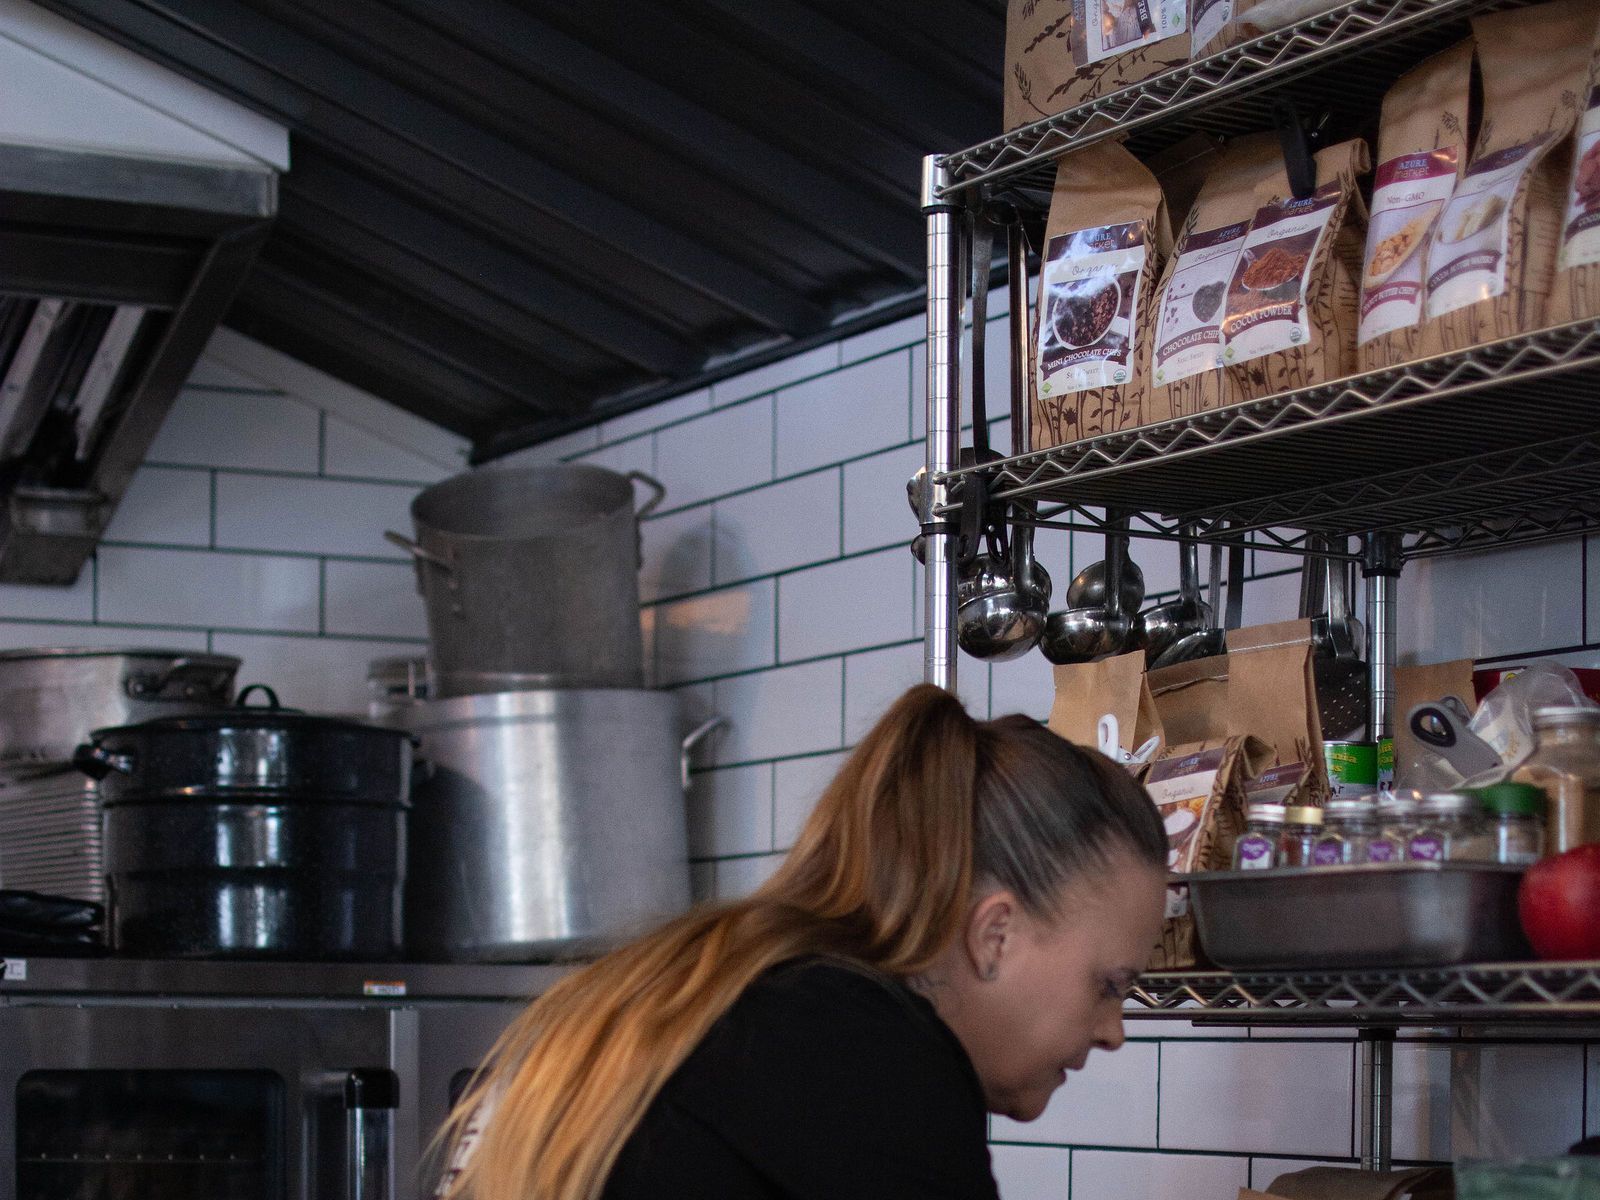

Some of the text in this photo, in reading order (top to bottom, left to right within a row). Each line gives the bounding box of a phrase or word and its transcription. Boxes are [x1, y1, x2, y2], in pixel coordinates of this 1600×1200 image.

[1230, 305, 1293, 333] COCOA POWDER
[1161, 331, 1204, 357] CHOCOLATE
[1047, 359, 1064, 371] MINI
[1063, 348, 1102, 364] CHOCOLATE
